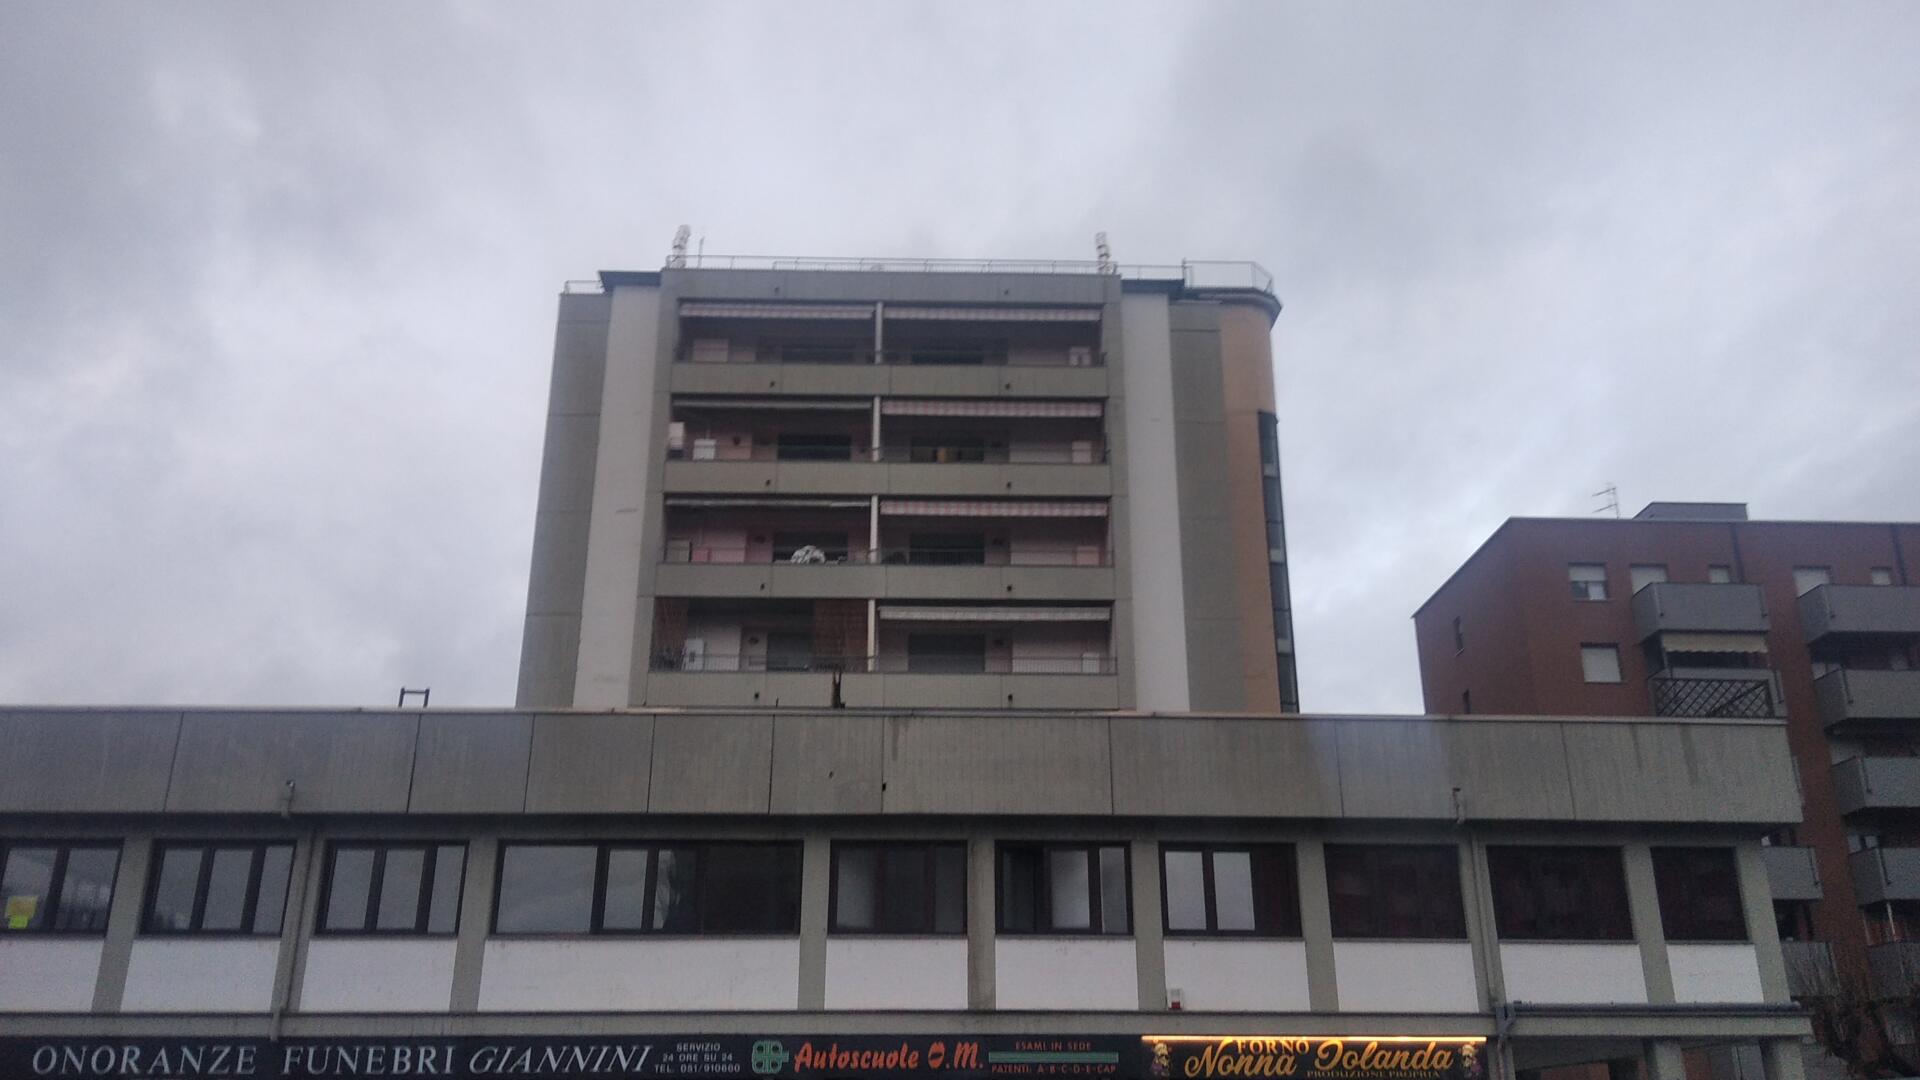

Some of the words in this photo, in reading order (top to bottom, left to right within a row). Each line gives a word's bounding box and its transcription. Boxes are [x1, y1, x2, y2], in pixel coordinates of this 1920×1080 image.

[676, 1042, 721, 1052] SERVIZIO
[1015, 1041, 1046, 1051] ESAMI
[1051, 1041, 1062, 1050] IN
[1067, 1041, 1091, 1050] SEDE
[1237, 1040, 1310, 1054] FORNO
[32, 1045, 257, 1075] ONORANZE
[281, 1045, 455, 1075] FUNEBRI
[468, 1045, 652, 1074] GIANNINI
[662, 1053, 674, 1062] 24
[679, 1053, 698, 1062] ORE
[704, 1053, 717, 1062] SU
[721, 1053, 733, 1062] 24
[794, 1041, 919, 1073] Autoscuole
[1184, 1038, 1298, 1078] Nonna
